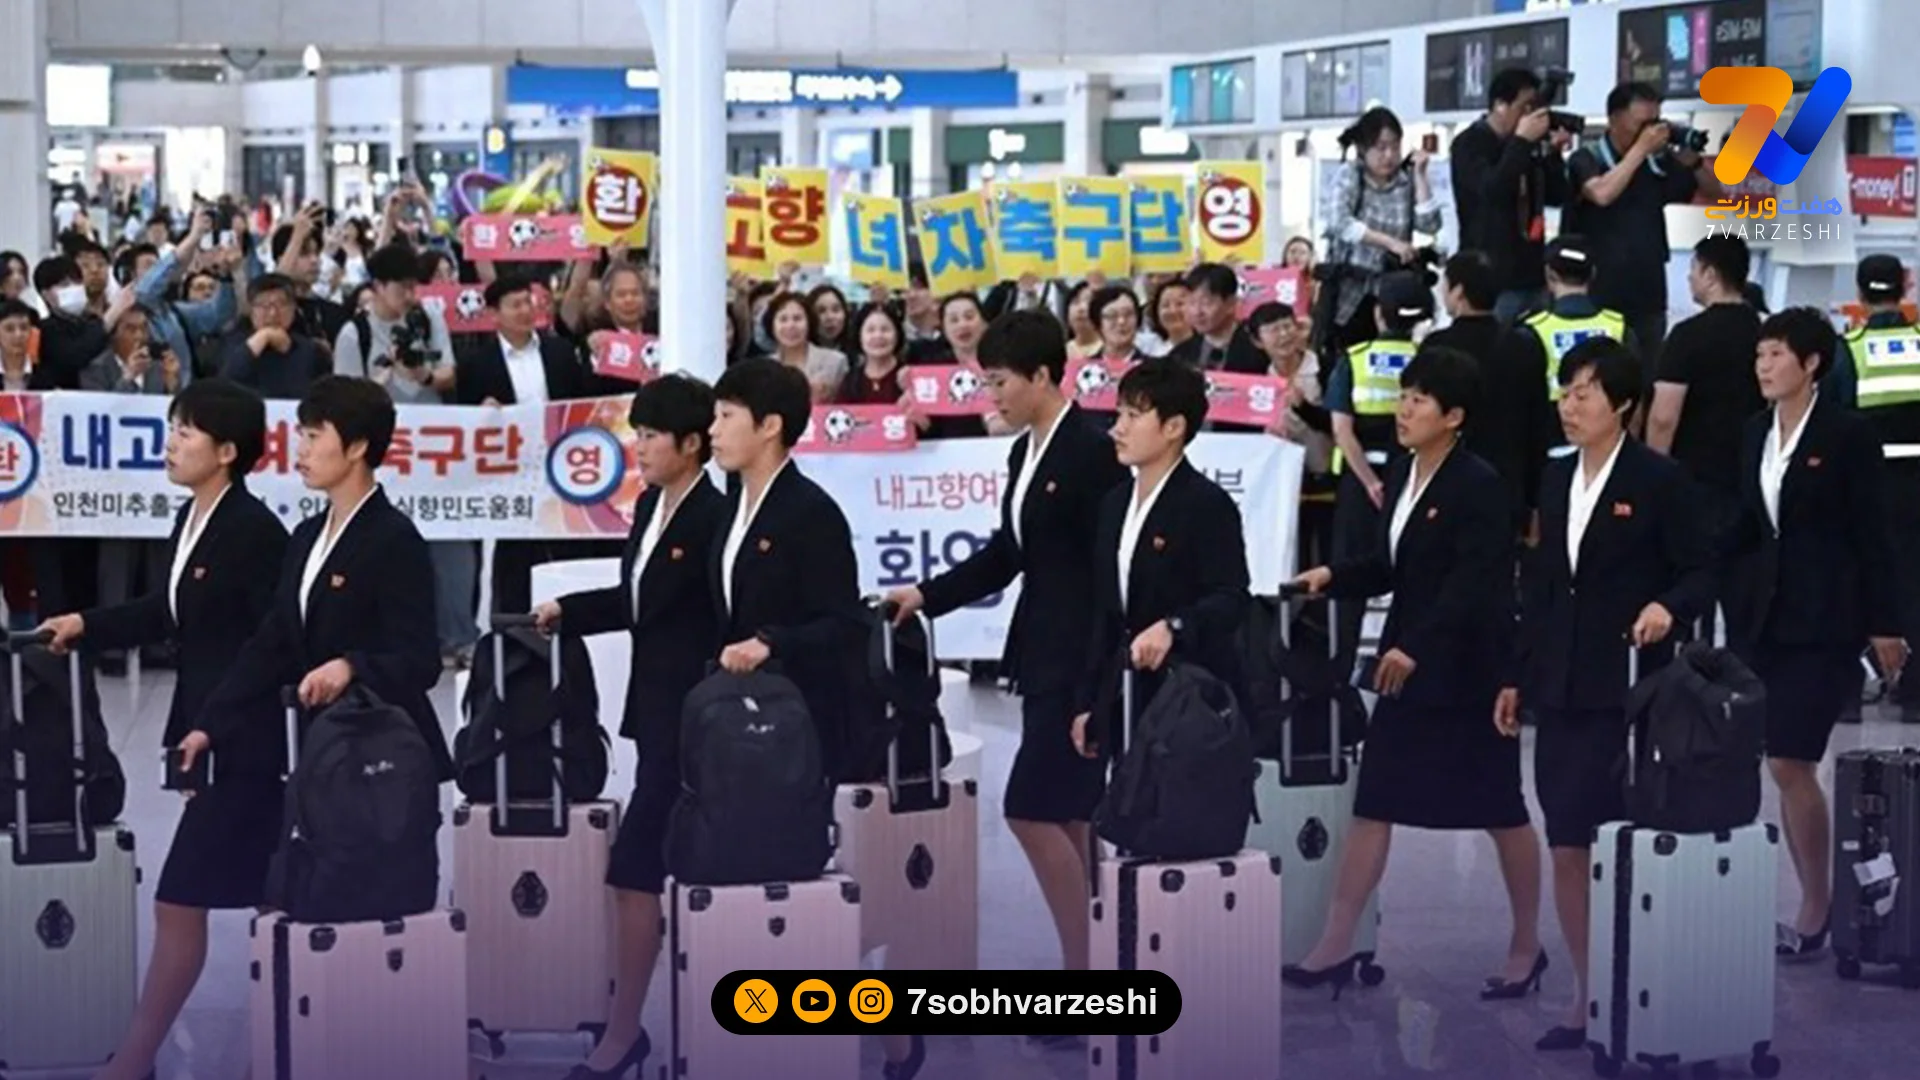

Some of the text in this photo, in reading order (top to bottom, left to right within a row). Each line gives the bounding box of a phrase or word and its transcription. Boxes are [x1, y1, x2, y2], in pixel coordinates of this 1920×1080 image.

[594, 172, 642, 224] 환
[766, 186, 824, 247] 향
[1065, 193, 1124, 259] 구
[1130, 190, 1184, 254] 단
[1203, 185, 1251, 240] 영
[847, 206, 902, 272] 녀
[923, 207, 986, 274] 자
[1000, 198, 1056, 261] 축
[566, 446, 601, 486] 영
[874, 470, 1009, 511] 내고향여
